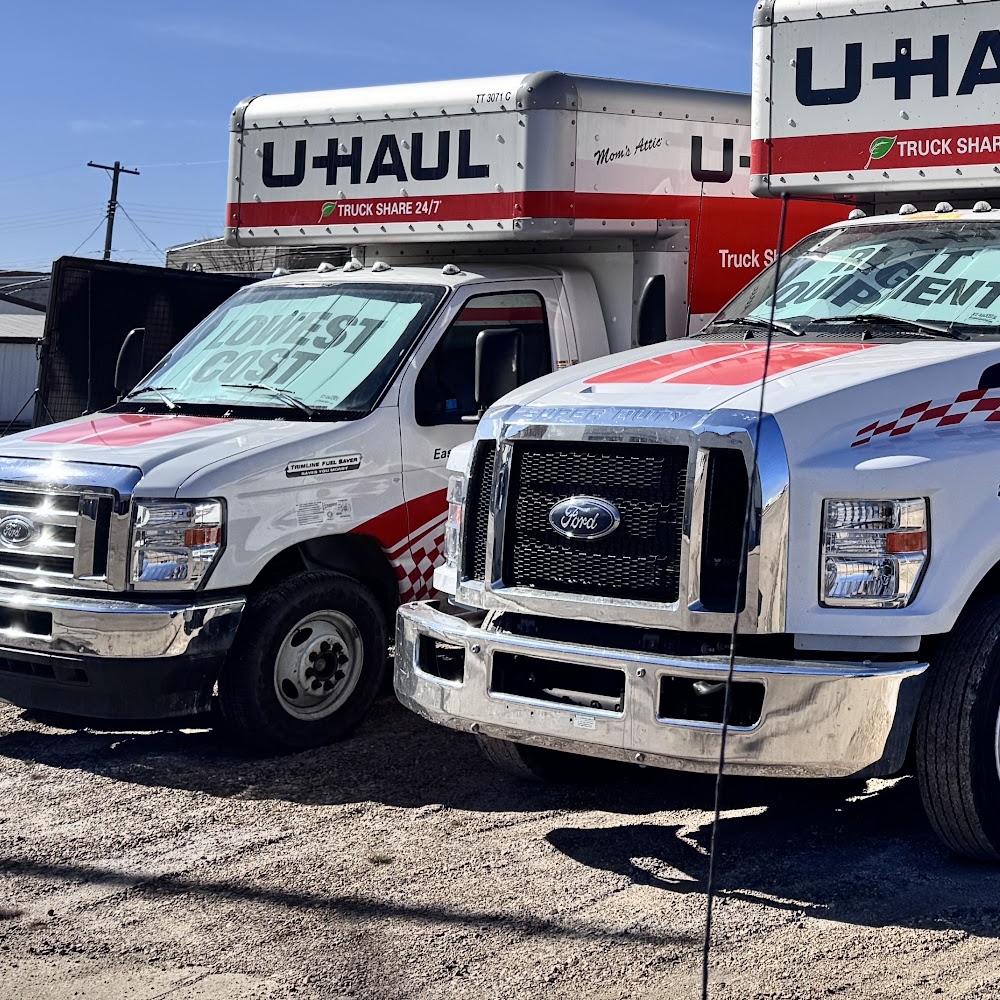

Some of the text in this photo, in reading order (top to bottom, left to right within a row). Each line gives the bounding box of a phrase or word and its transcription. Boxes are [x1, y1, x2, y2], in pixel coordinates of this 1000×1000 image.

[475, 90, 512, 104] TT 3071 C
[262, 128, 490, 188] U-HAUL
[594, 136, 663, 166] Mom's Attic
[896, 138, 952, 158] TRUCK
[690, 136, 750, 184] U-
[337, 199, 441, 218] TRUCK SHARE 24/7
[718, 248, 760, 268] Truck
[203, 310, 387, 354] LOWEST
[192, 348, 321, 384] COST
[4, 523, 22, 537] Ford
[560, 507, 600, 530] Ford
